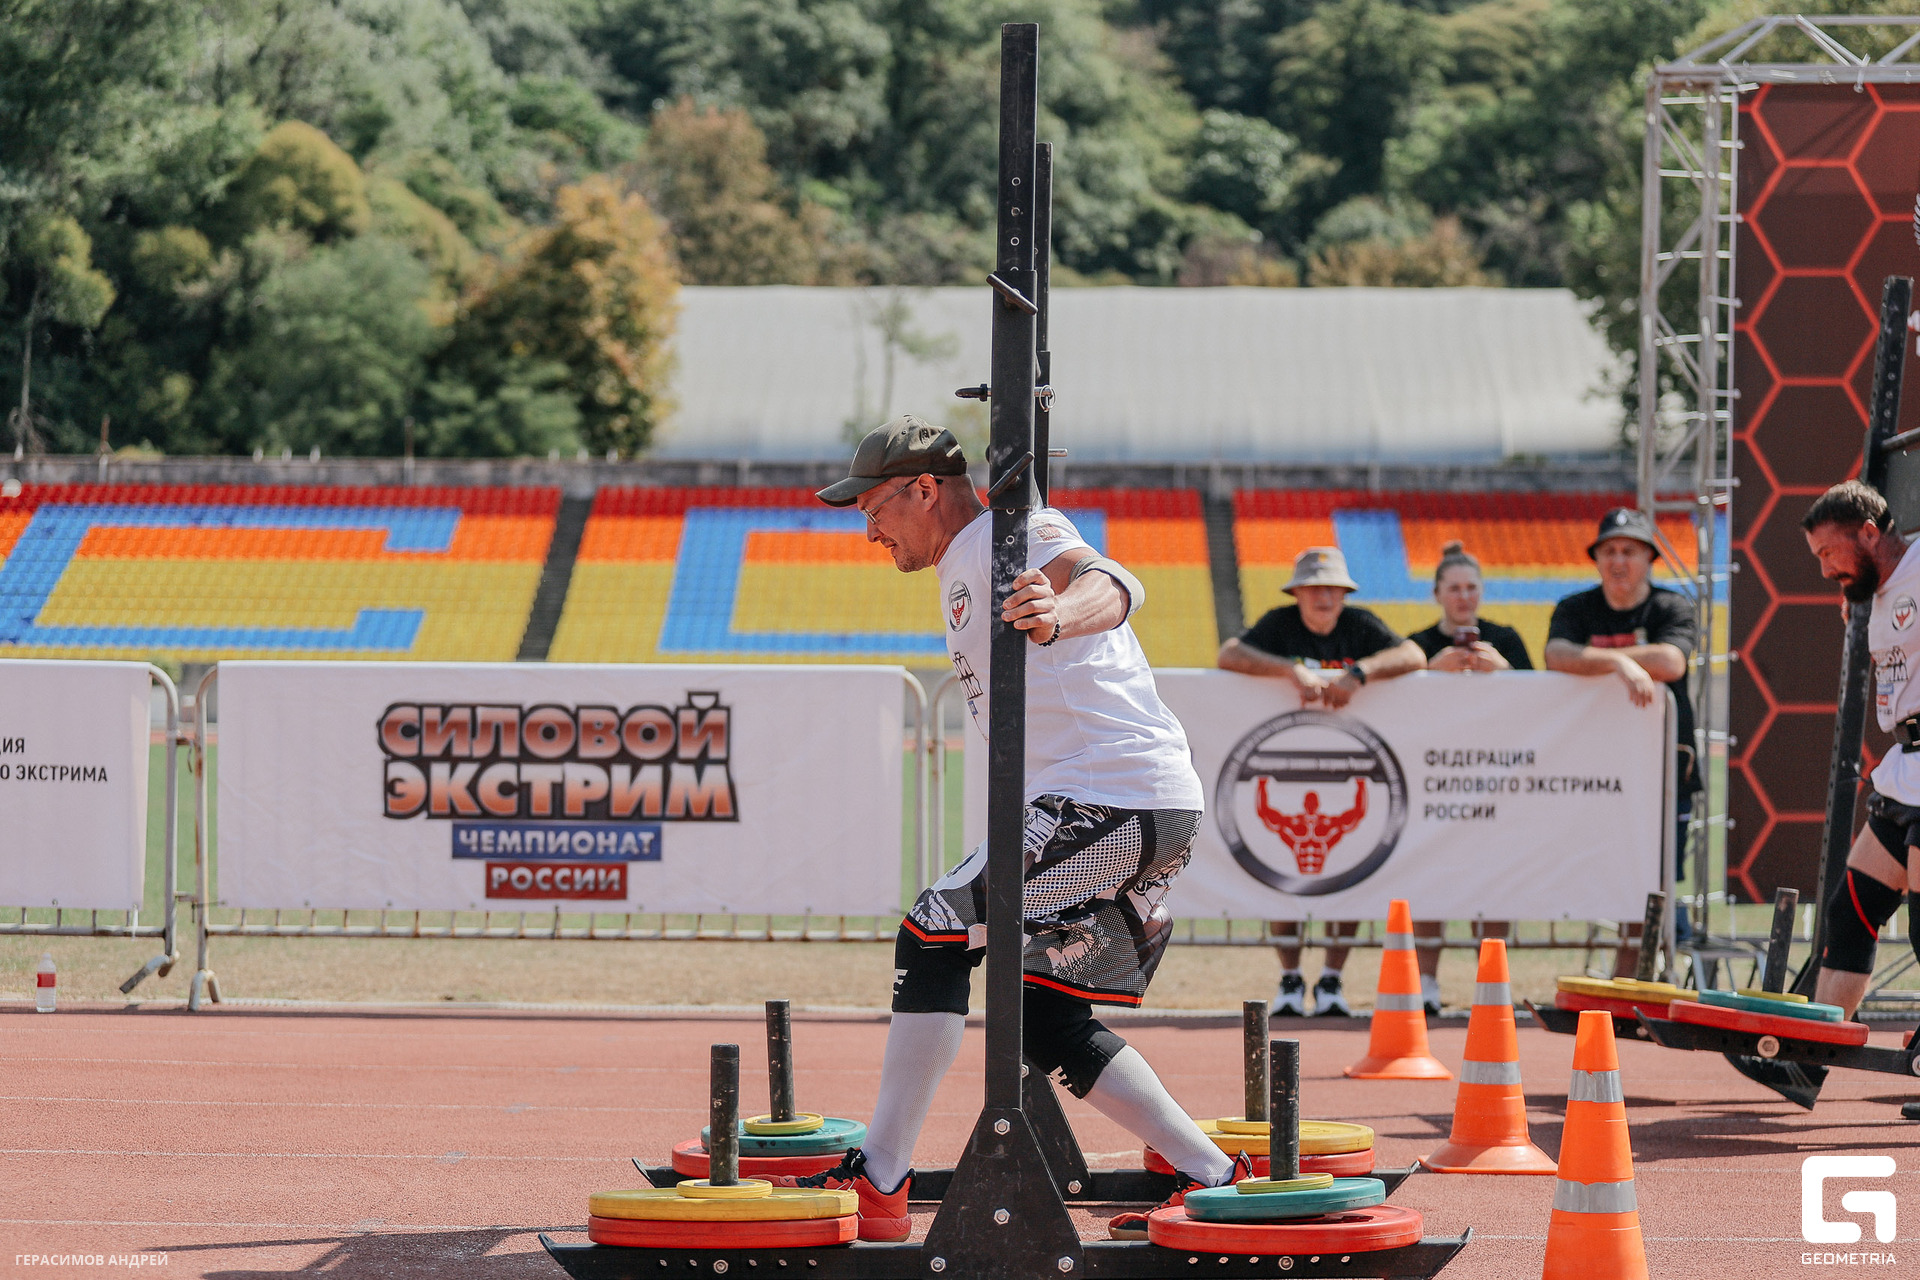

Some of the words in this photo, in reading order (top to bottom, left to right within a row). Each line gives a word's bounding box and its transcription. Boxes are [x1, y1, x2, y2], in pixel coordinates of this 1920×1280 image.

[377, 691, 731, 762] СИЛОВОЙ
[0, 737, 25, 755] ИЯ
[1424, 749, 1536, 767] ФЕДЕРАЦИЯ
[16, 764, 108, 782] ЭКСТРИМА
[384, 758, 739, 822] ЭКСТРИМ
[1424, 777, 1520, 793] СИЛОВОГО
[1525, 777, 1623, 793] ЭКСТРИМА
[1424, 803, 1496, 819] РОССИИ
[458, 830, 655, 855] ЧЕМПИОНАТ
[490, 865, 622, 892] РОССИИ
